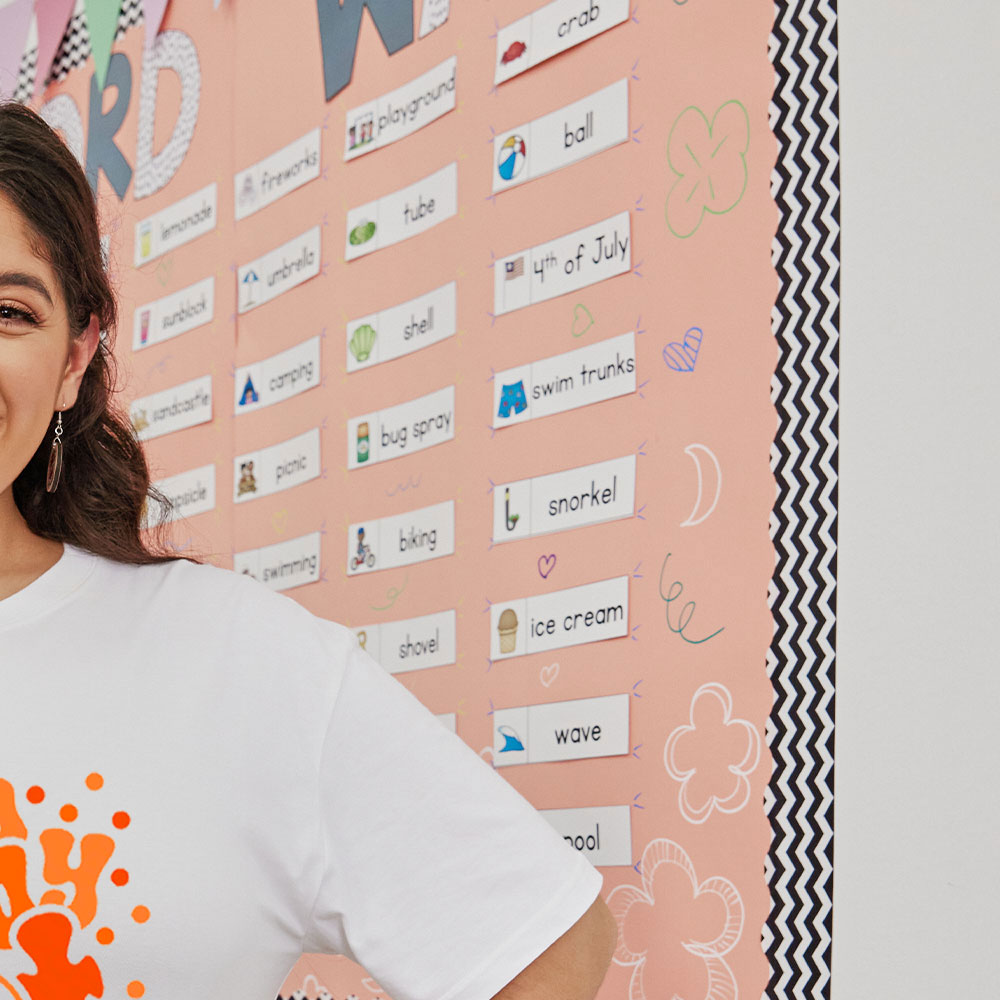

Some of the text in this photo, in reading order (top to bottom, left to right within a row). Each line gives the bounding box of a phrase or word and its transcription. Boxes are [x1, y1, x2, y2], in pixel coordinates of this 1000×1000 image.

[557, 0, 600, 38] crab
[377, 66, 456, 137] playground
[564, 111, 594, 149] ball
[261, 147, 318, 195] fireworks
[161, 200, 212, 241] lemonade
[403, 194, 436, 226] tube
[268, 246, 315, 287] umbrella
[533, 230, 628, 283] 4th of July
[162, 293, 208, 330] sunblock
[403, 306, 434, 342] shell
[268, 360, 314, 393] camping
[532, 352, 635, 400] swim trunks
[381, 411, 452, 449] bug spray
[275, 454, 308, 485] picnic
[548, 475, 617, 517] snorkel
[399, 526, 438, 552] biking
[262, 555, 317, 583] swimming
[531, 604, 624, 638] ice cream
[398, 627, 440, 660] shovel
[554, 724, 602, 745] wave
